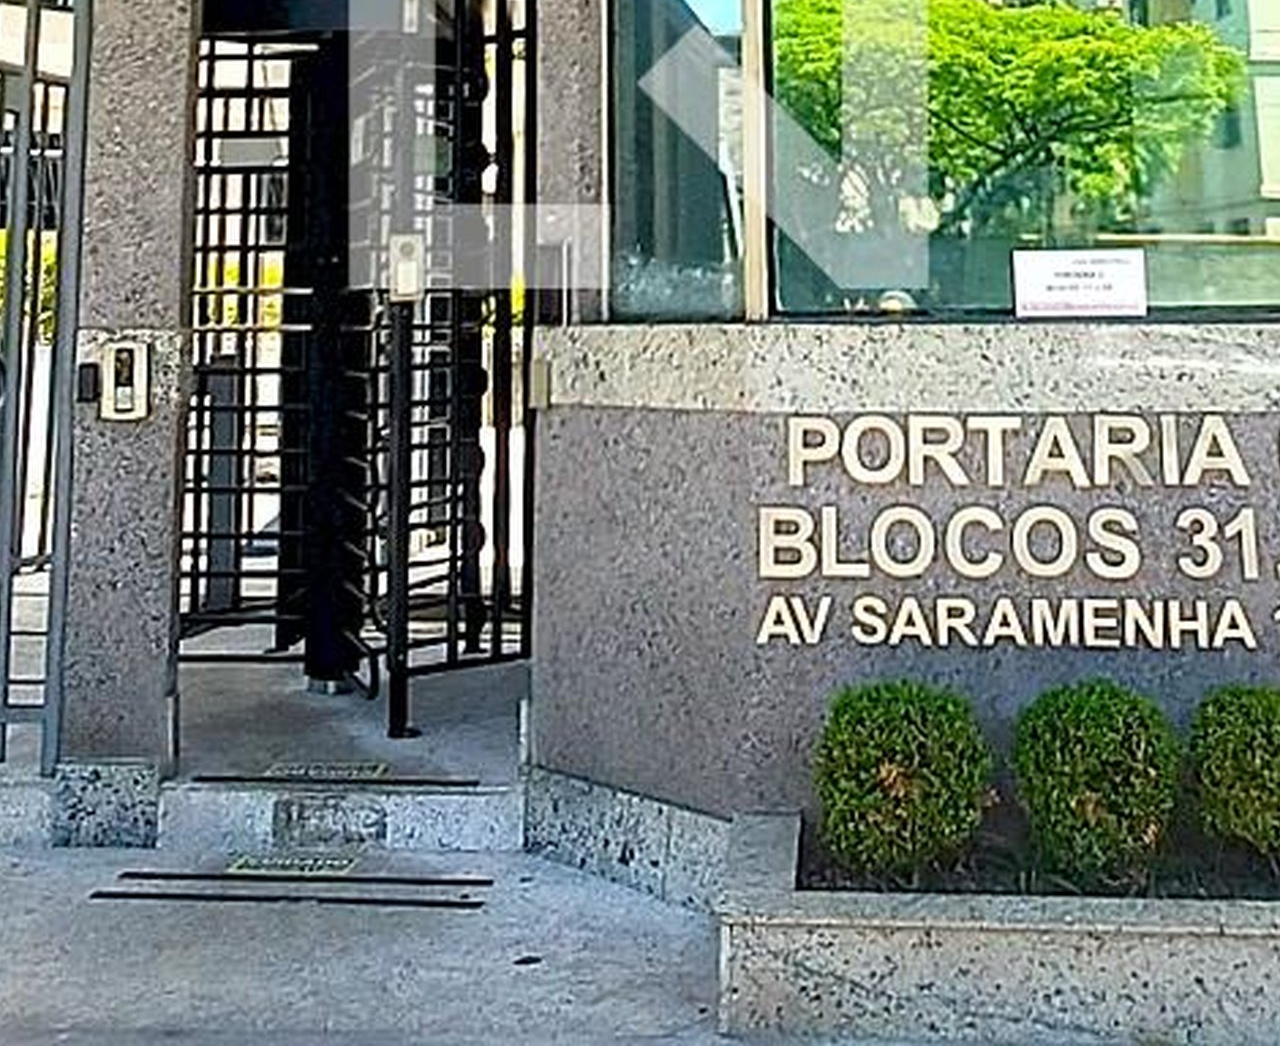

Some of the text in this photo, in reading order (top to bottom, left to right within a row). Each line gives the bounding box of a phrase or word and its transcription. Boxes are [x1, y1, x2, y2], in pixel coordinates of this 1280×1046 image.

[786, 415, 1252, 487] PORTARIA
[756, 506, 1141, 580] BLOCOS
[756, 596, 831, 645] AV
[851, 596, 1256, 649] SARAMENHA
